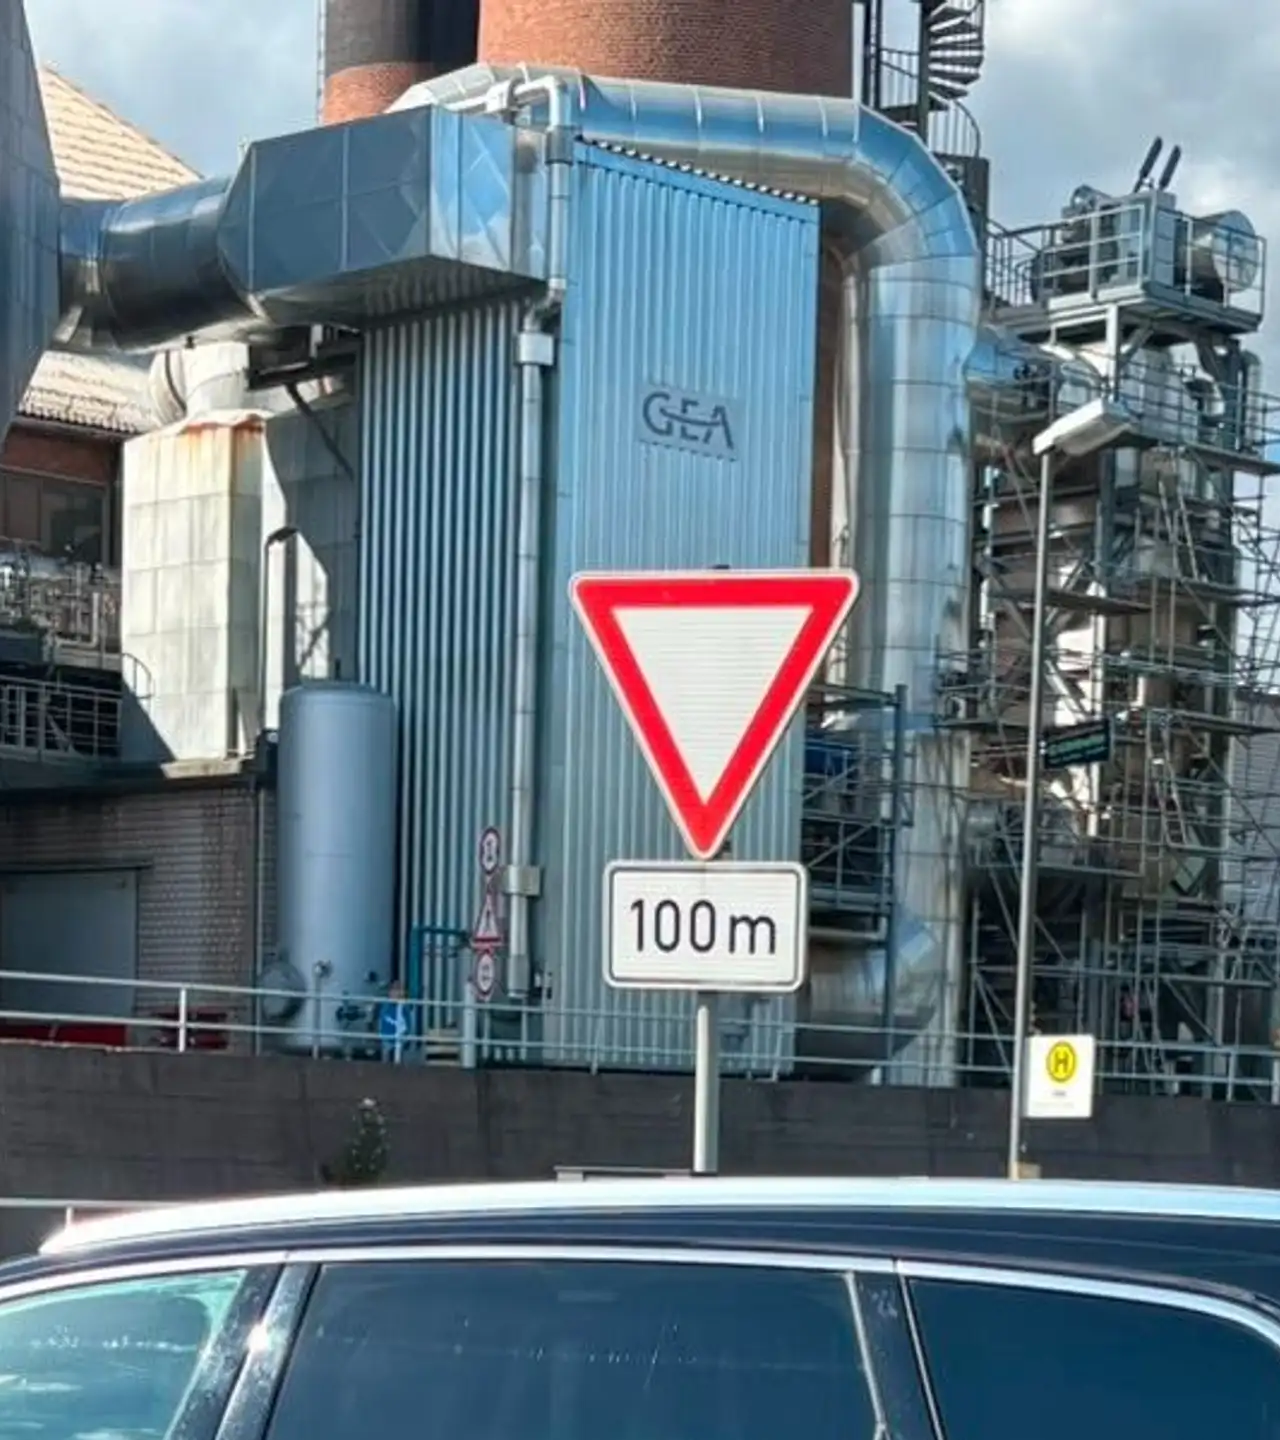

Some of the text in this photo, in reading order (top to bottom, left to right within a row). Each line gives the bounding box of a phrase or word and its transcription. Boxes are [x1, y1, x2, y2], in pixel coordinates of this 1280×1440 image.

[642, 391, 734, 450] GEA
[631, 899, 776, 955] 100 m
